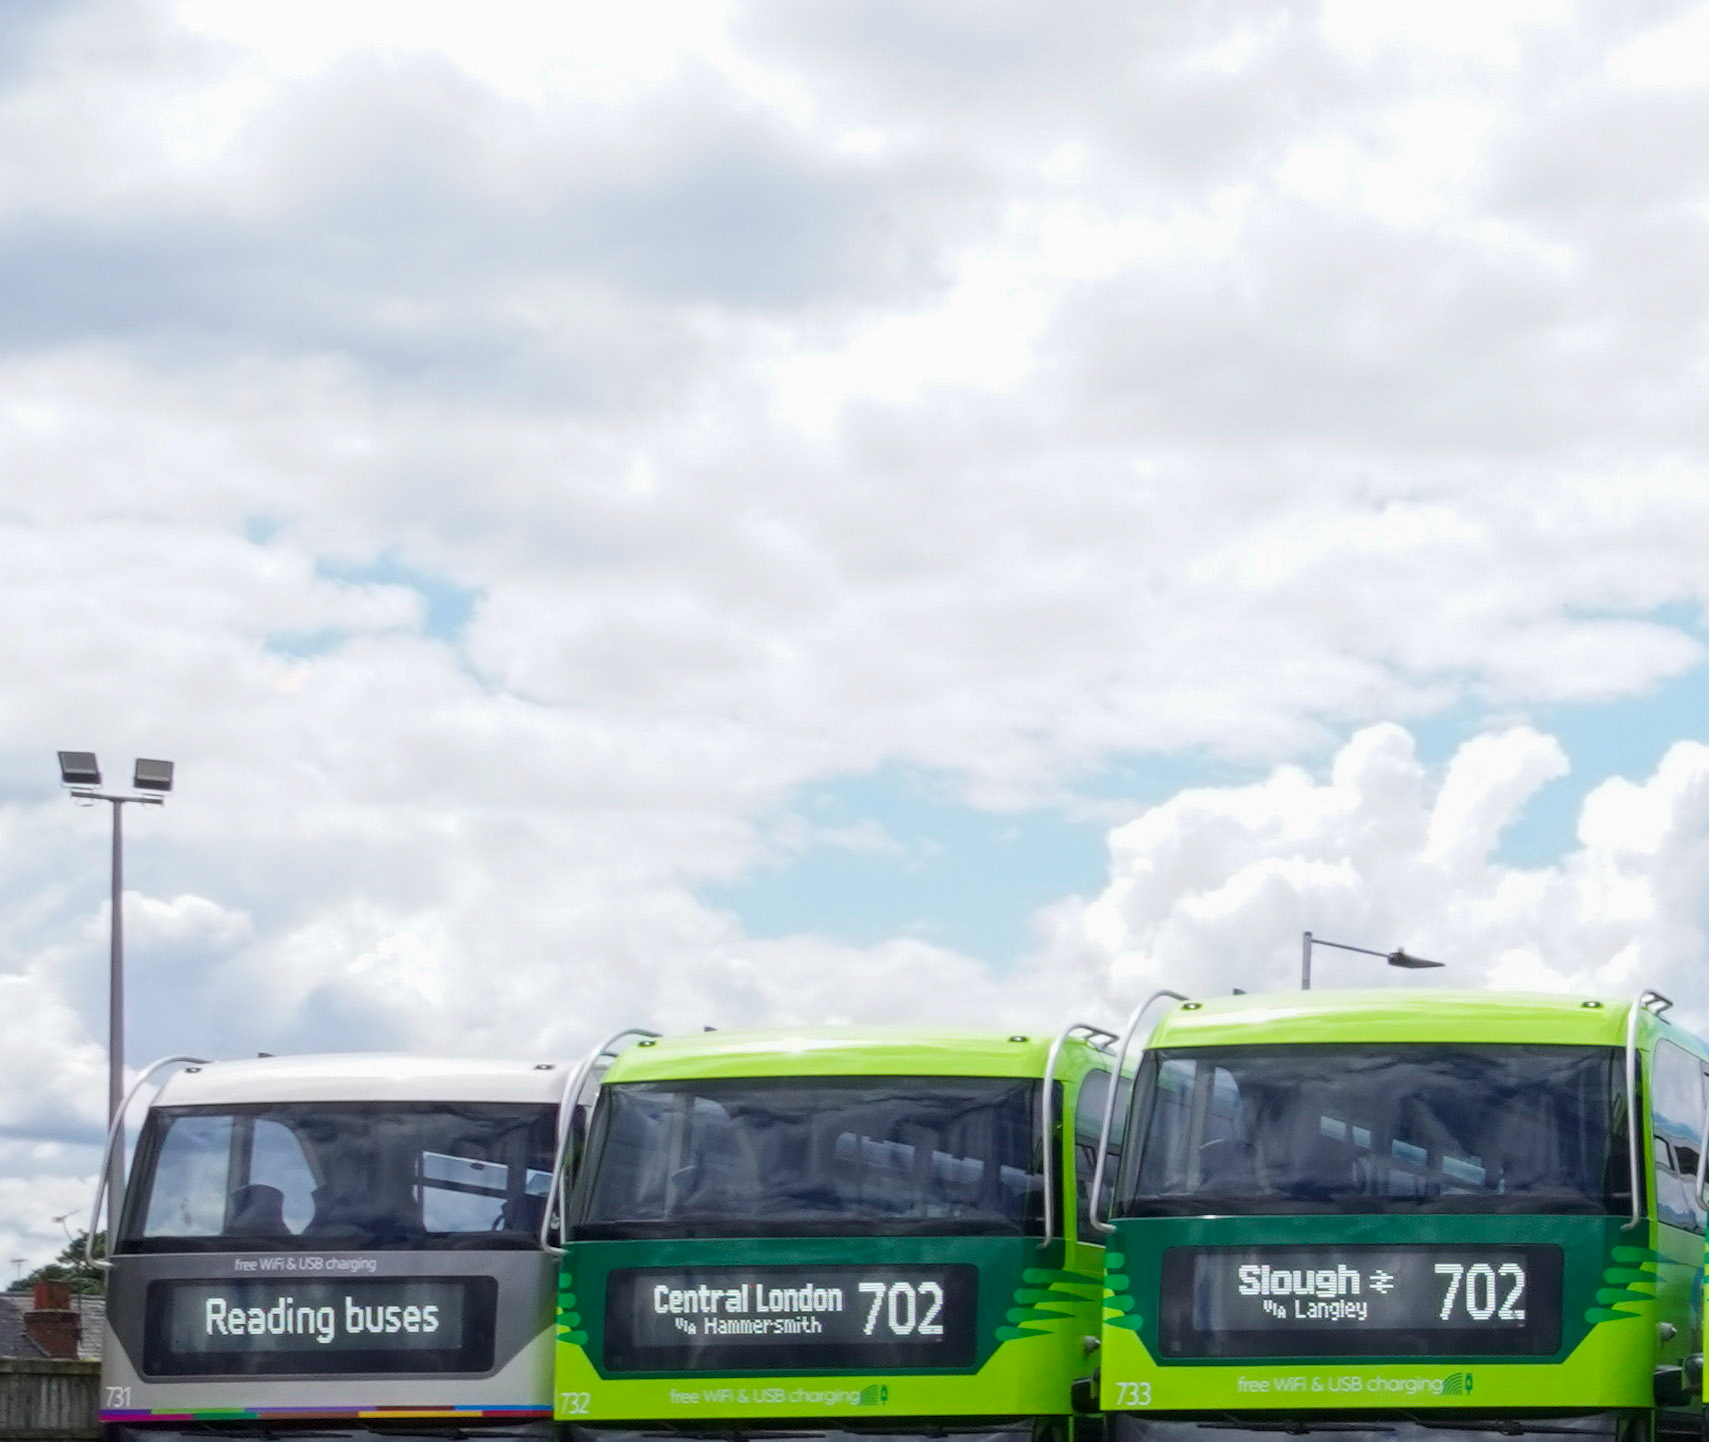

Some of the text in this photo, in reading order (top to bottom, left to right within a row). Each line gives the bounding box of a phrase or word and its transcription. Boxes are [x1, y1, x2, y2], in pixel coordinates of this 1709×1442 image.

[234, 1257, 377, 1273] free WiFi & USB charging
[1238, 1263, 1526, 1321] Slough 702
[205, 1296, 440, 1343] Reading buses
[653, 1282, 944, 1336] Central London 702
[1294, 1299, 1368, 1321] Langley
[703, 1316, 823, 1334] Hammersmith
[669, 1388, 861, 1406] free WiFi & USB charging
[1115, 1382, 1153, 1407] 733
[1237, 1376, 1445, 1396] free WiFi & USB charging
[106, 1387, 131, 1408] 731
[560, 1392, 591, 1415] 732
